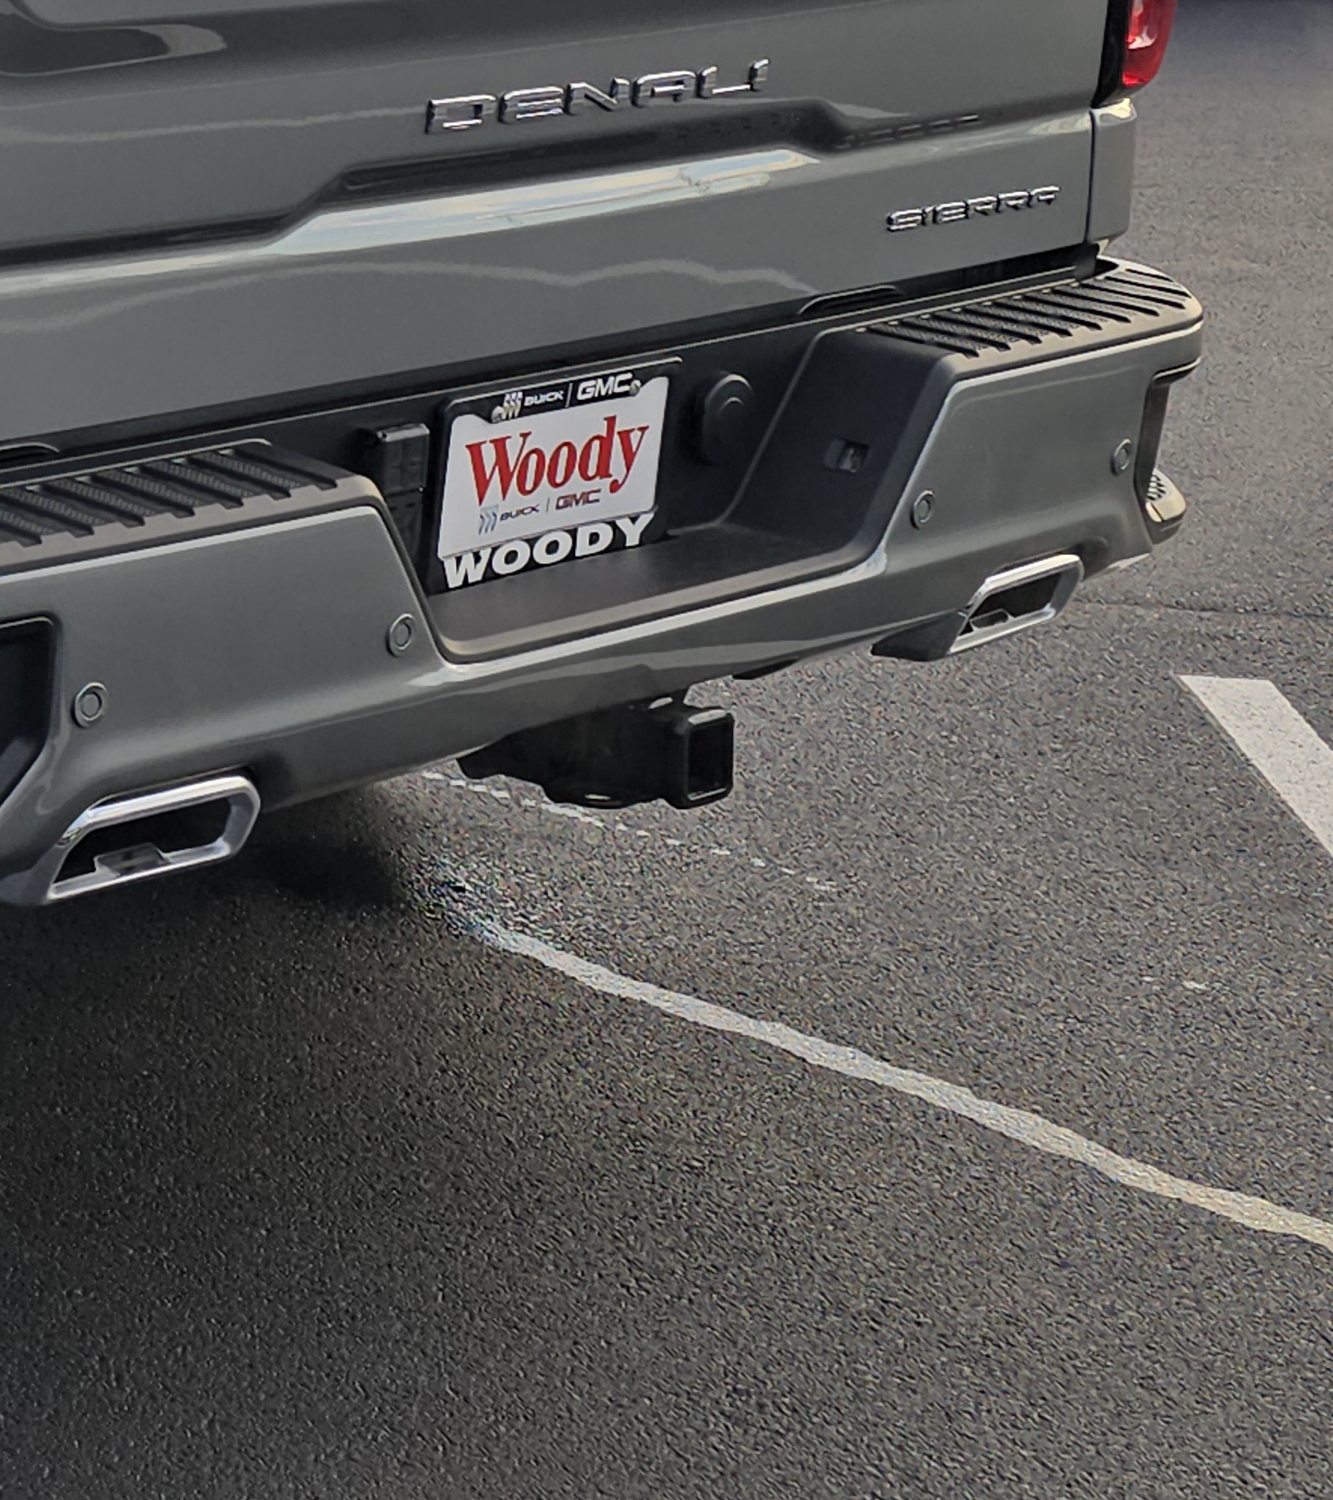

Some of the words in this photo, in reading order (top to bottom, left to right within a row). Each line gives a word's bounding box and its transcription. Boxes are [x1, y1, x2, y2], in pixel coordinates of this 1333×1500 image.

[425, 58, 770, 133] DENALI
[885, 185, 1060, 233] SIERRA
[524, 390, 564, 406] BUICK
[577, 373, 633, 400] GMC
[465, 415, 649, 506] Woody
[500, 504, 540, 522] BUICK
[556, 489, 601, 510] GMC
[441, 512, 655, 589] WOODY
